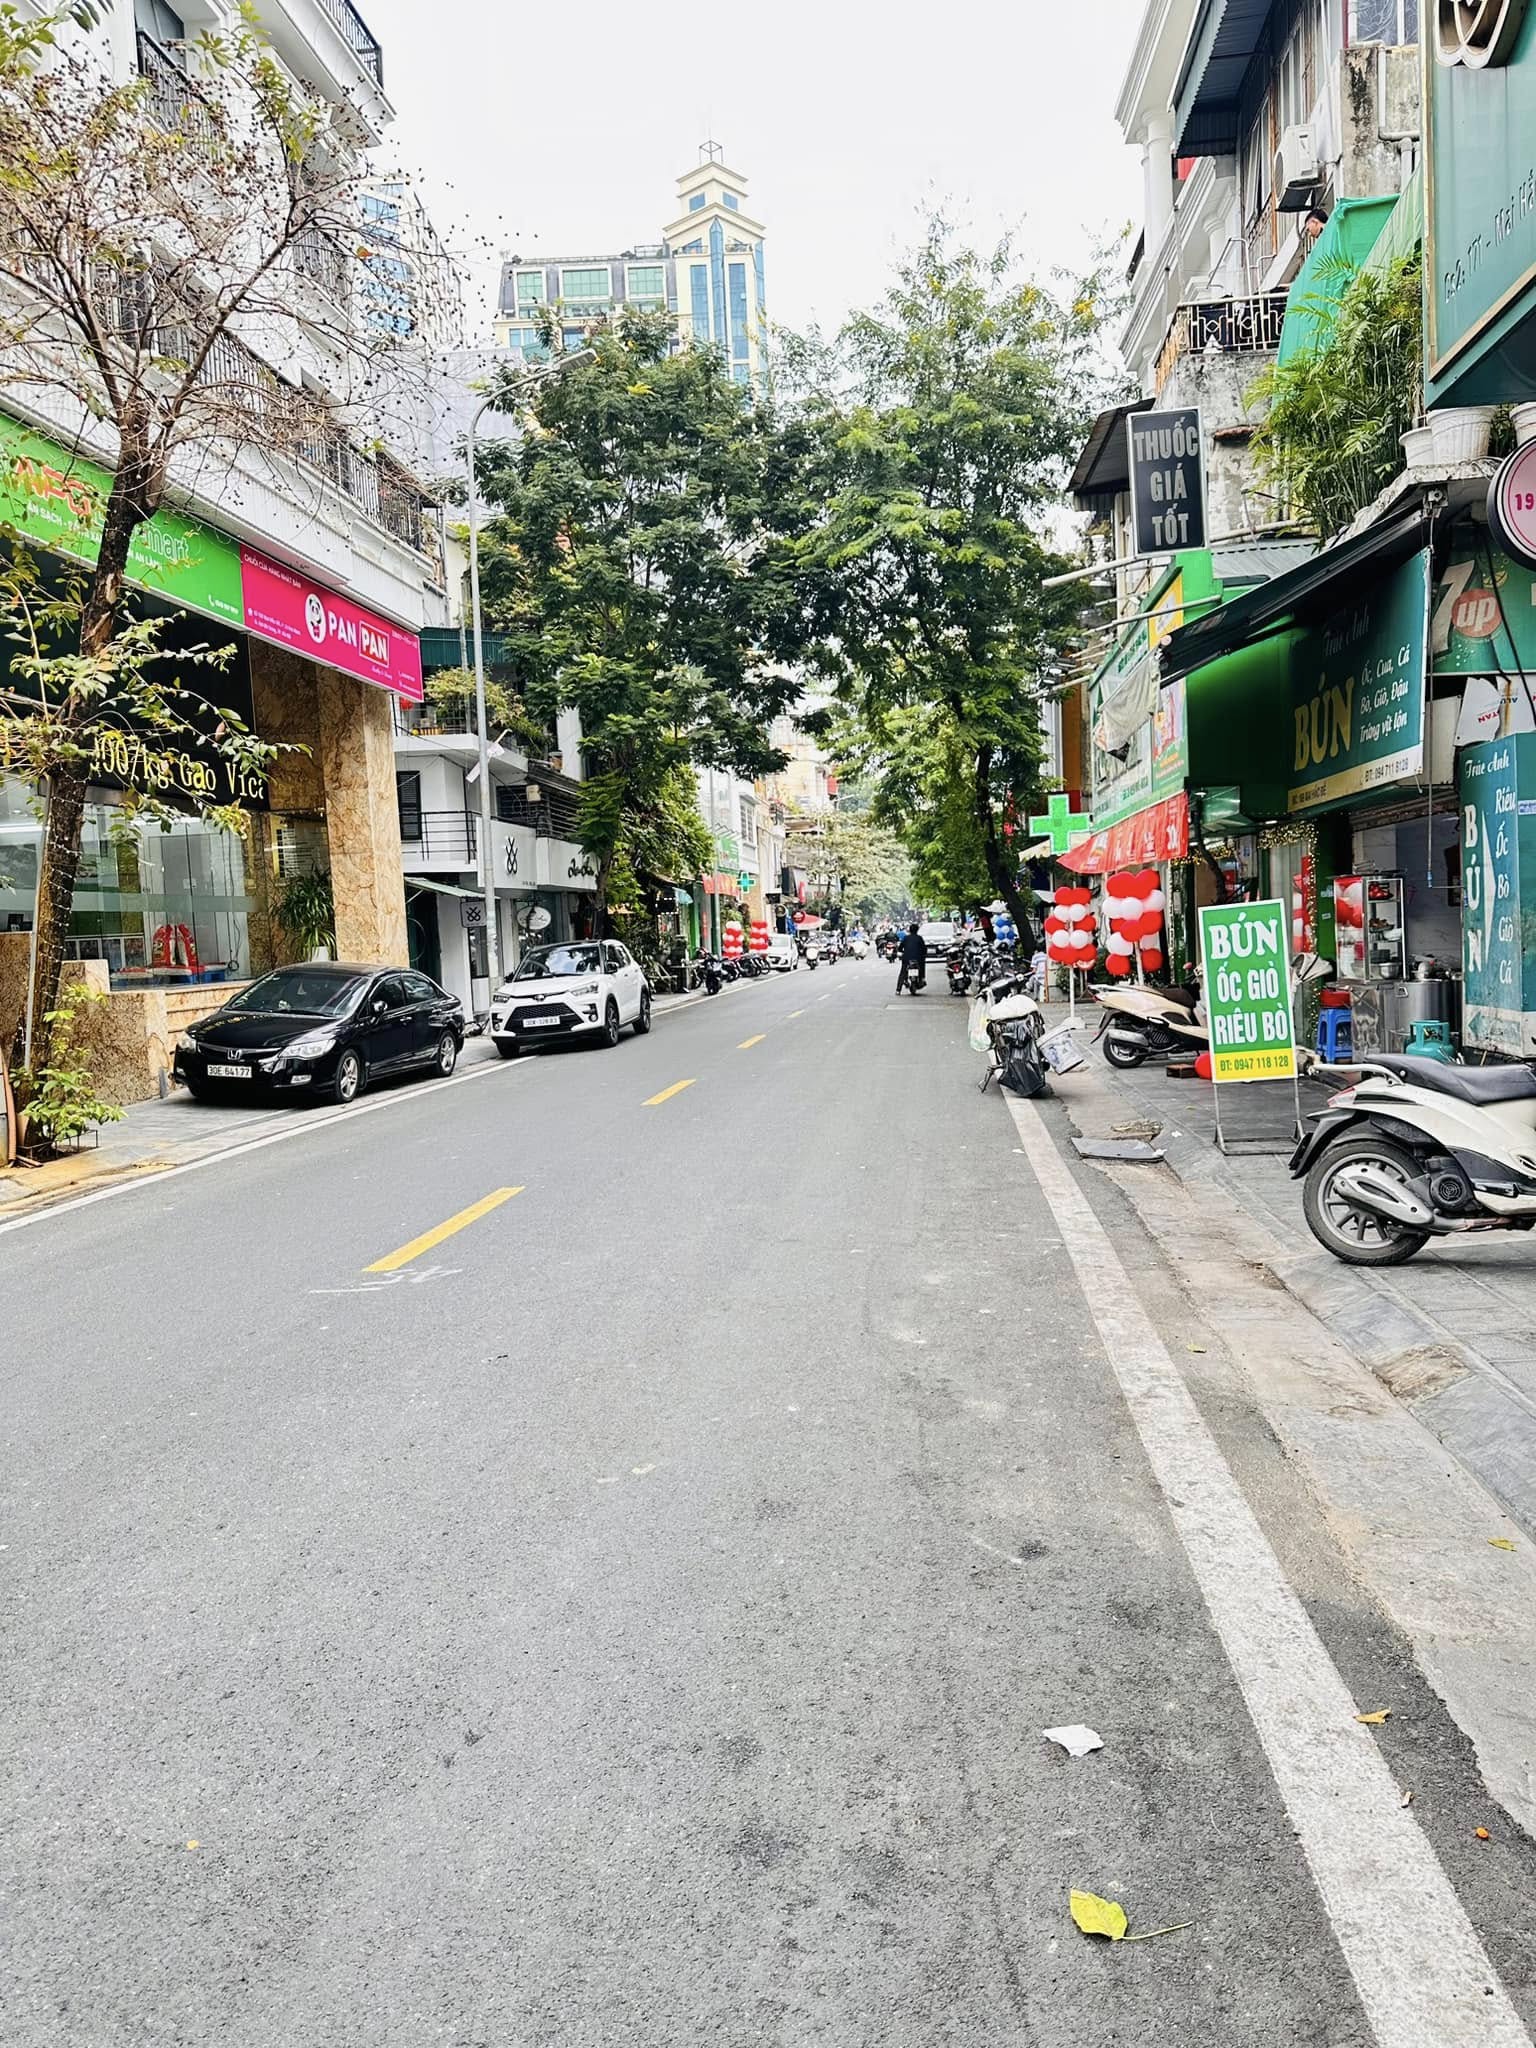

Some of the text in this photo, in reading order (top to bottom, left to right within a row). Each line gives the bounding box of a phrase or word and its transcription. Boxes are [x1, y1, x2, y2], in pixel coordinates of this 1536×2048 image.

[1494, 195, 1515, 248] Mai
[1518, 168, 1536, 221] Hắ
[1133, 416, 1199, 462] THUỐC
[1150, 462, 1188, 502] GIÁ
[1151, 502, 1189, 546] TỐT
[328, 610, 357, 648] PAN
[361, 627, 388, 661] PAN
[1397, 643, 1411, 668] Cá
[1294, 671, 1355, 772] BÚN
[1497, 873, 1510, 899] Bò
[1208, 911, 1278, 959] BÚN
[1498, 915, 1514, 943] Giò
[1216, 960, 1280, 1003] ỐC GIÒ
[1499, 957, 1513, 985] Cá
[1214, 1002, 1289, 1045] RIÊU BÒ
[1220, 1055, 1289, 1072] ĐT: 0947 118 128
